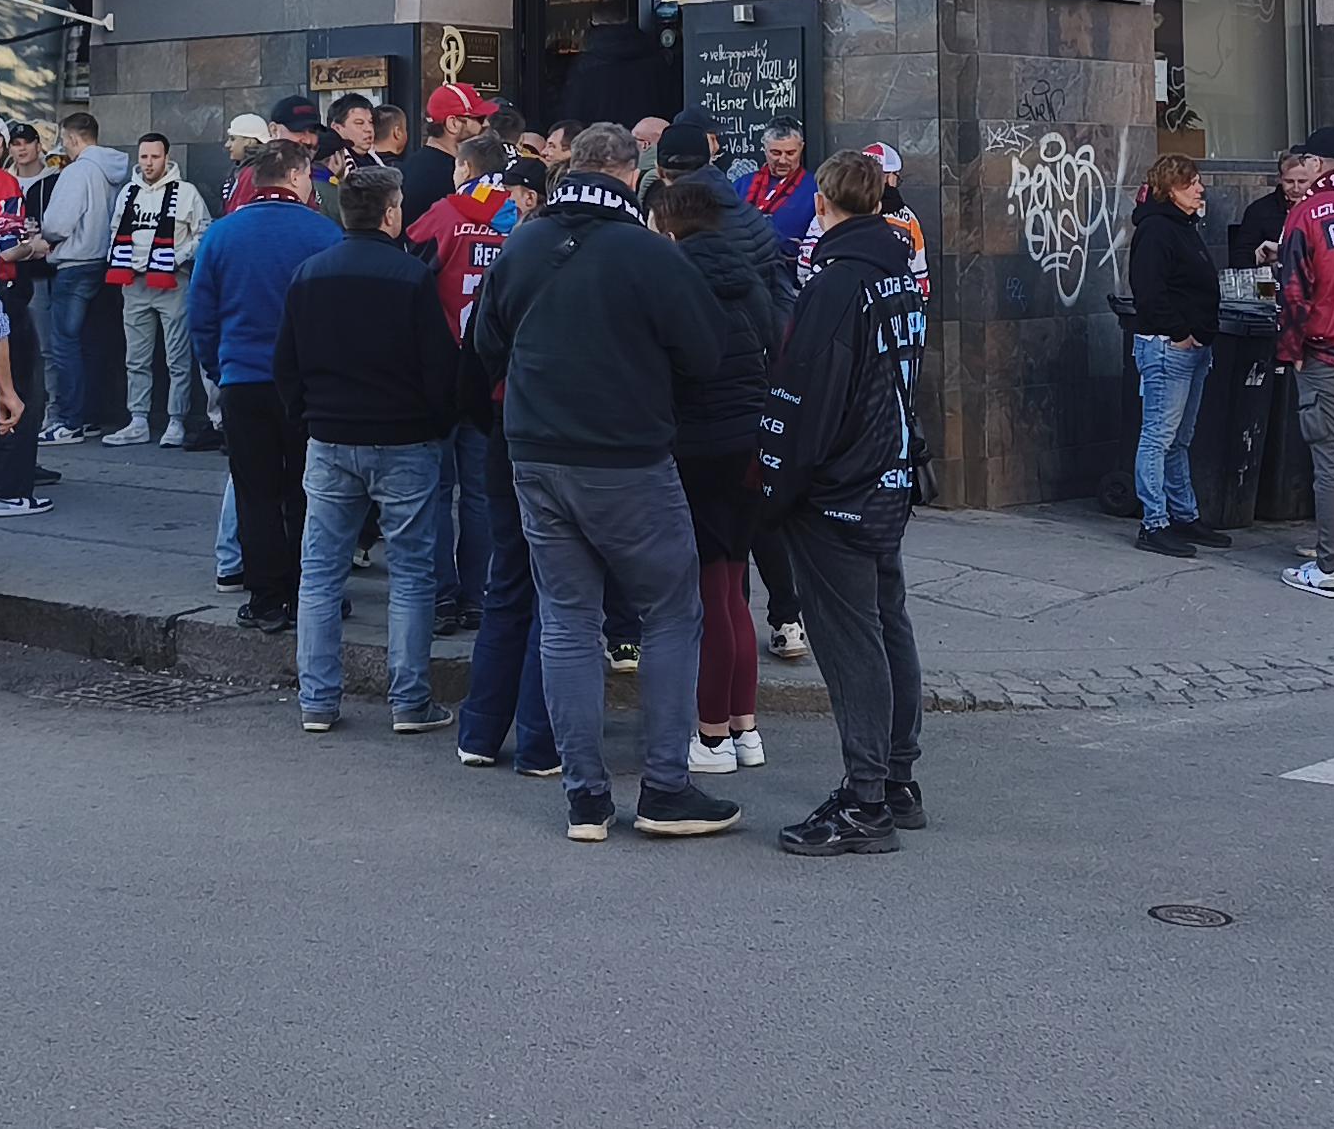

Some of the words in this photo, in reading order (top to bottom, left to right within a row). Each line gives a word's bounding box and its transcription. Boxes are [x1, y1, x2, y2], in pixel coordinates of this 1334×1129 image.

[706, 92, 748, 112] Pilsner
[753, 85, 796, 116] Urquell
[771, 387, 802, 405] ufland
[759, 414, 785, 434] KB
[824, 509, 862, 521] ATLETICO
